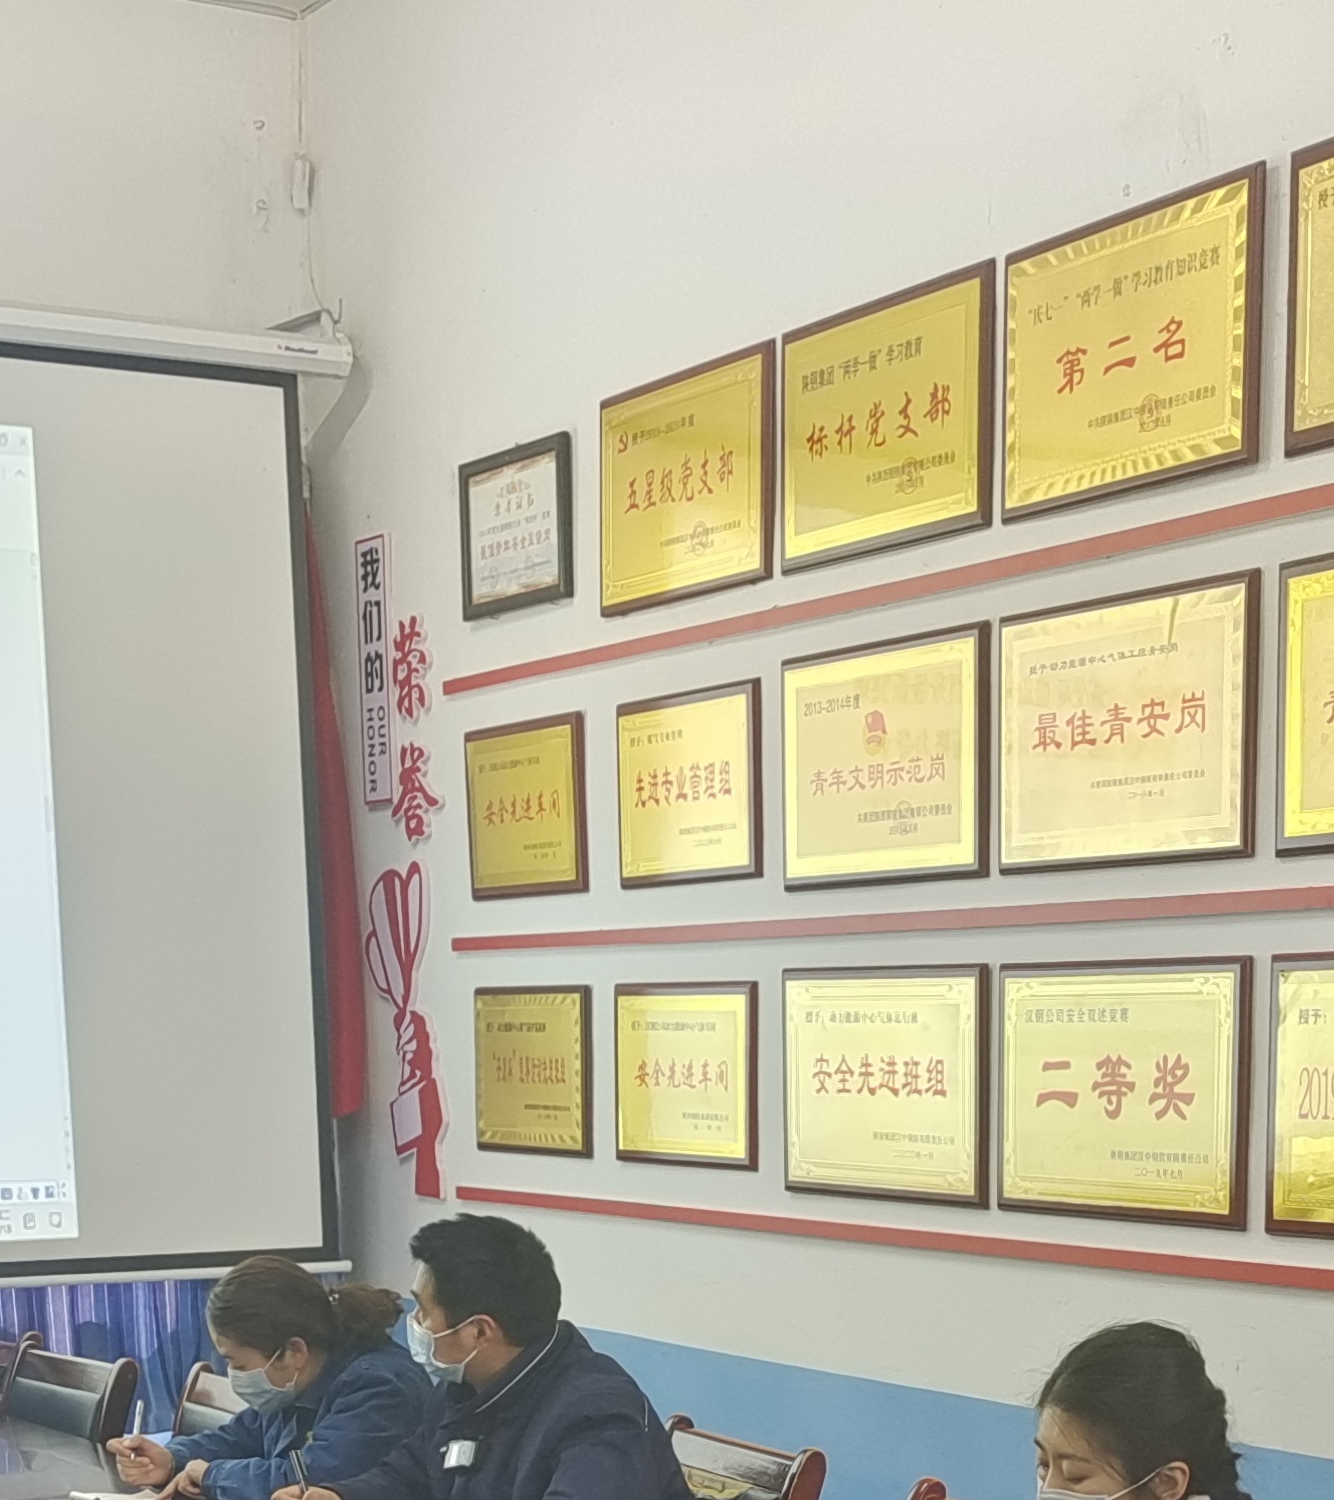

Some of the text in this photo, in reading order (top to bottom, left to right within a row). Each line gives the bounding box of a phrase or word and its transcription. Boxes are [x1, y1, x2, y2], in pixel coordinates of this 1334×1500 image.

[1056, 316, 1186, 395] 第二名
[806, 382, 952, 462] 标杆党支部
[624, 443, 734, 514] 五星级党支部
[360, 546, 385, 694] 我们的
[366, 708, 378, 794] HONOR
[377, 705, 386, 757] OUR
[392, 615, 440, 841] 荣誉
[1032, 690, 1207, 752] 最佳青安岗
[635, 760, 732, 809] 先进专业管理组
[810, 753, 946, 796] 青年文明示范岗
[483, 789, 561, 827] 安全先进车间
[634, 1058, 729, 1093] 安全先进车间
[812, 1053, 947, 1098] 安全先进班组
[1036, 1053, 1195, 1120] 二等奖
